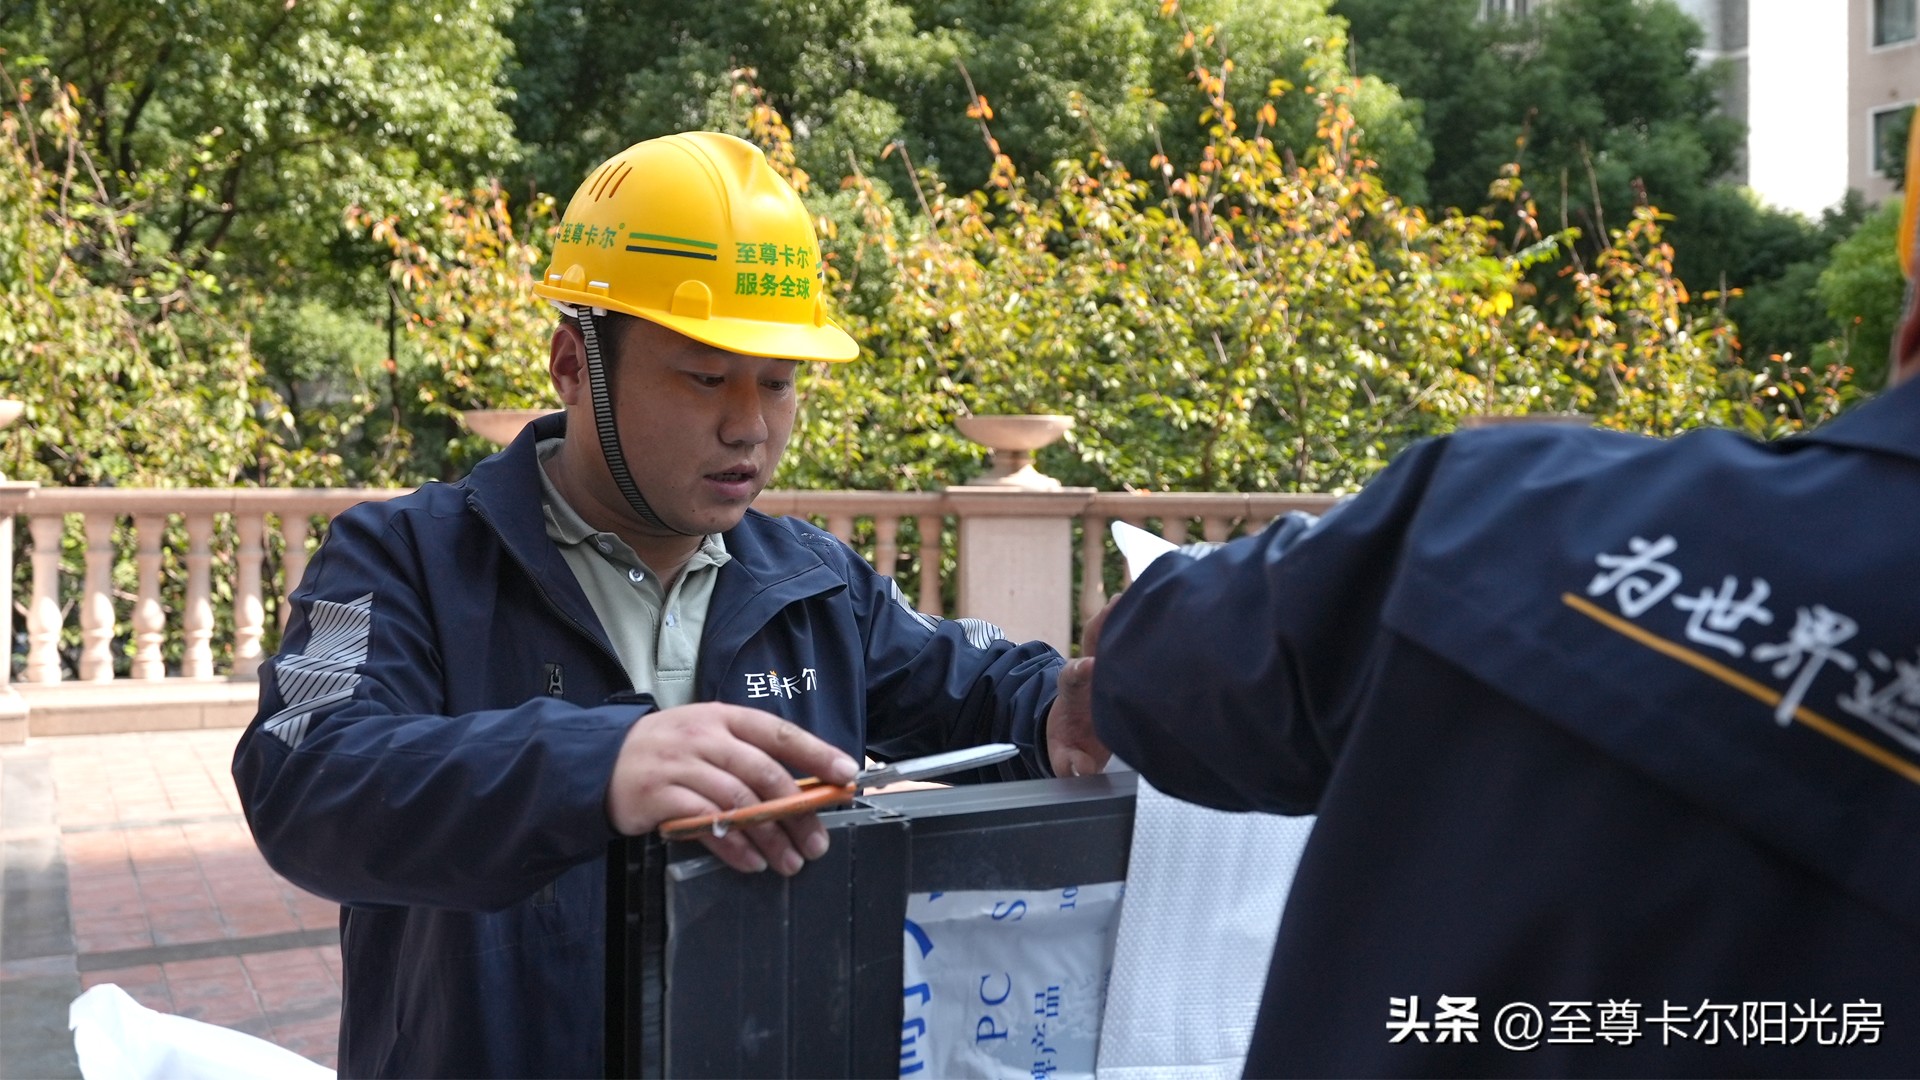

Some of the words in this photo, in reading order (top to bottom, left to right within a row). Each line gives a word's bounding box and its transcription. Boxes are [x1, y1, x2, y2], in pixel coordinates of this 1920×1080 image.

[735, 242, 810, 269] 至尊卡尔
[735, 272, 811, 299] 服务全球
